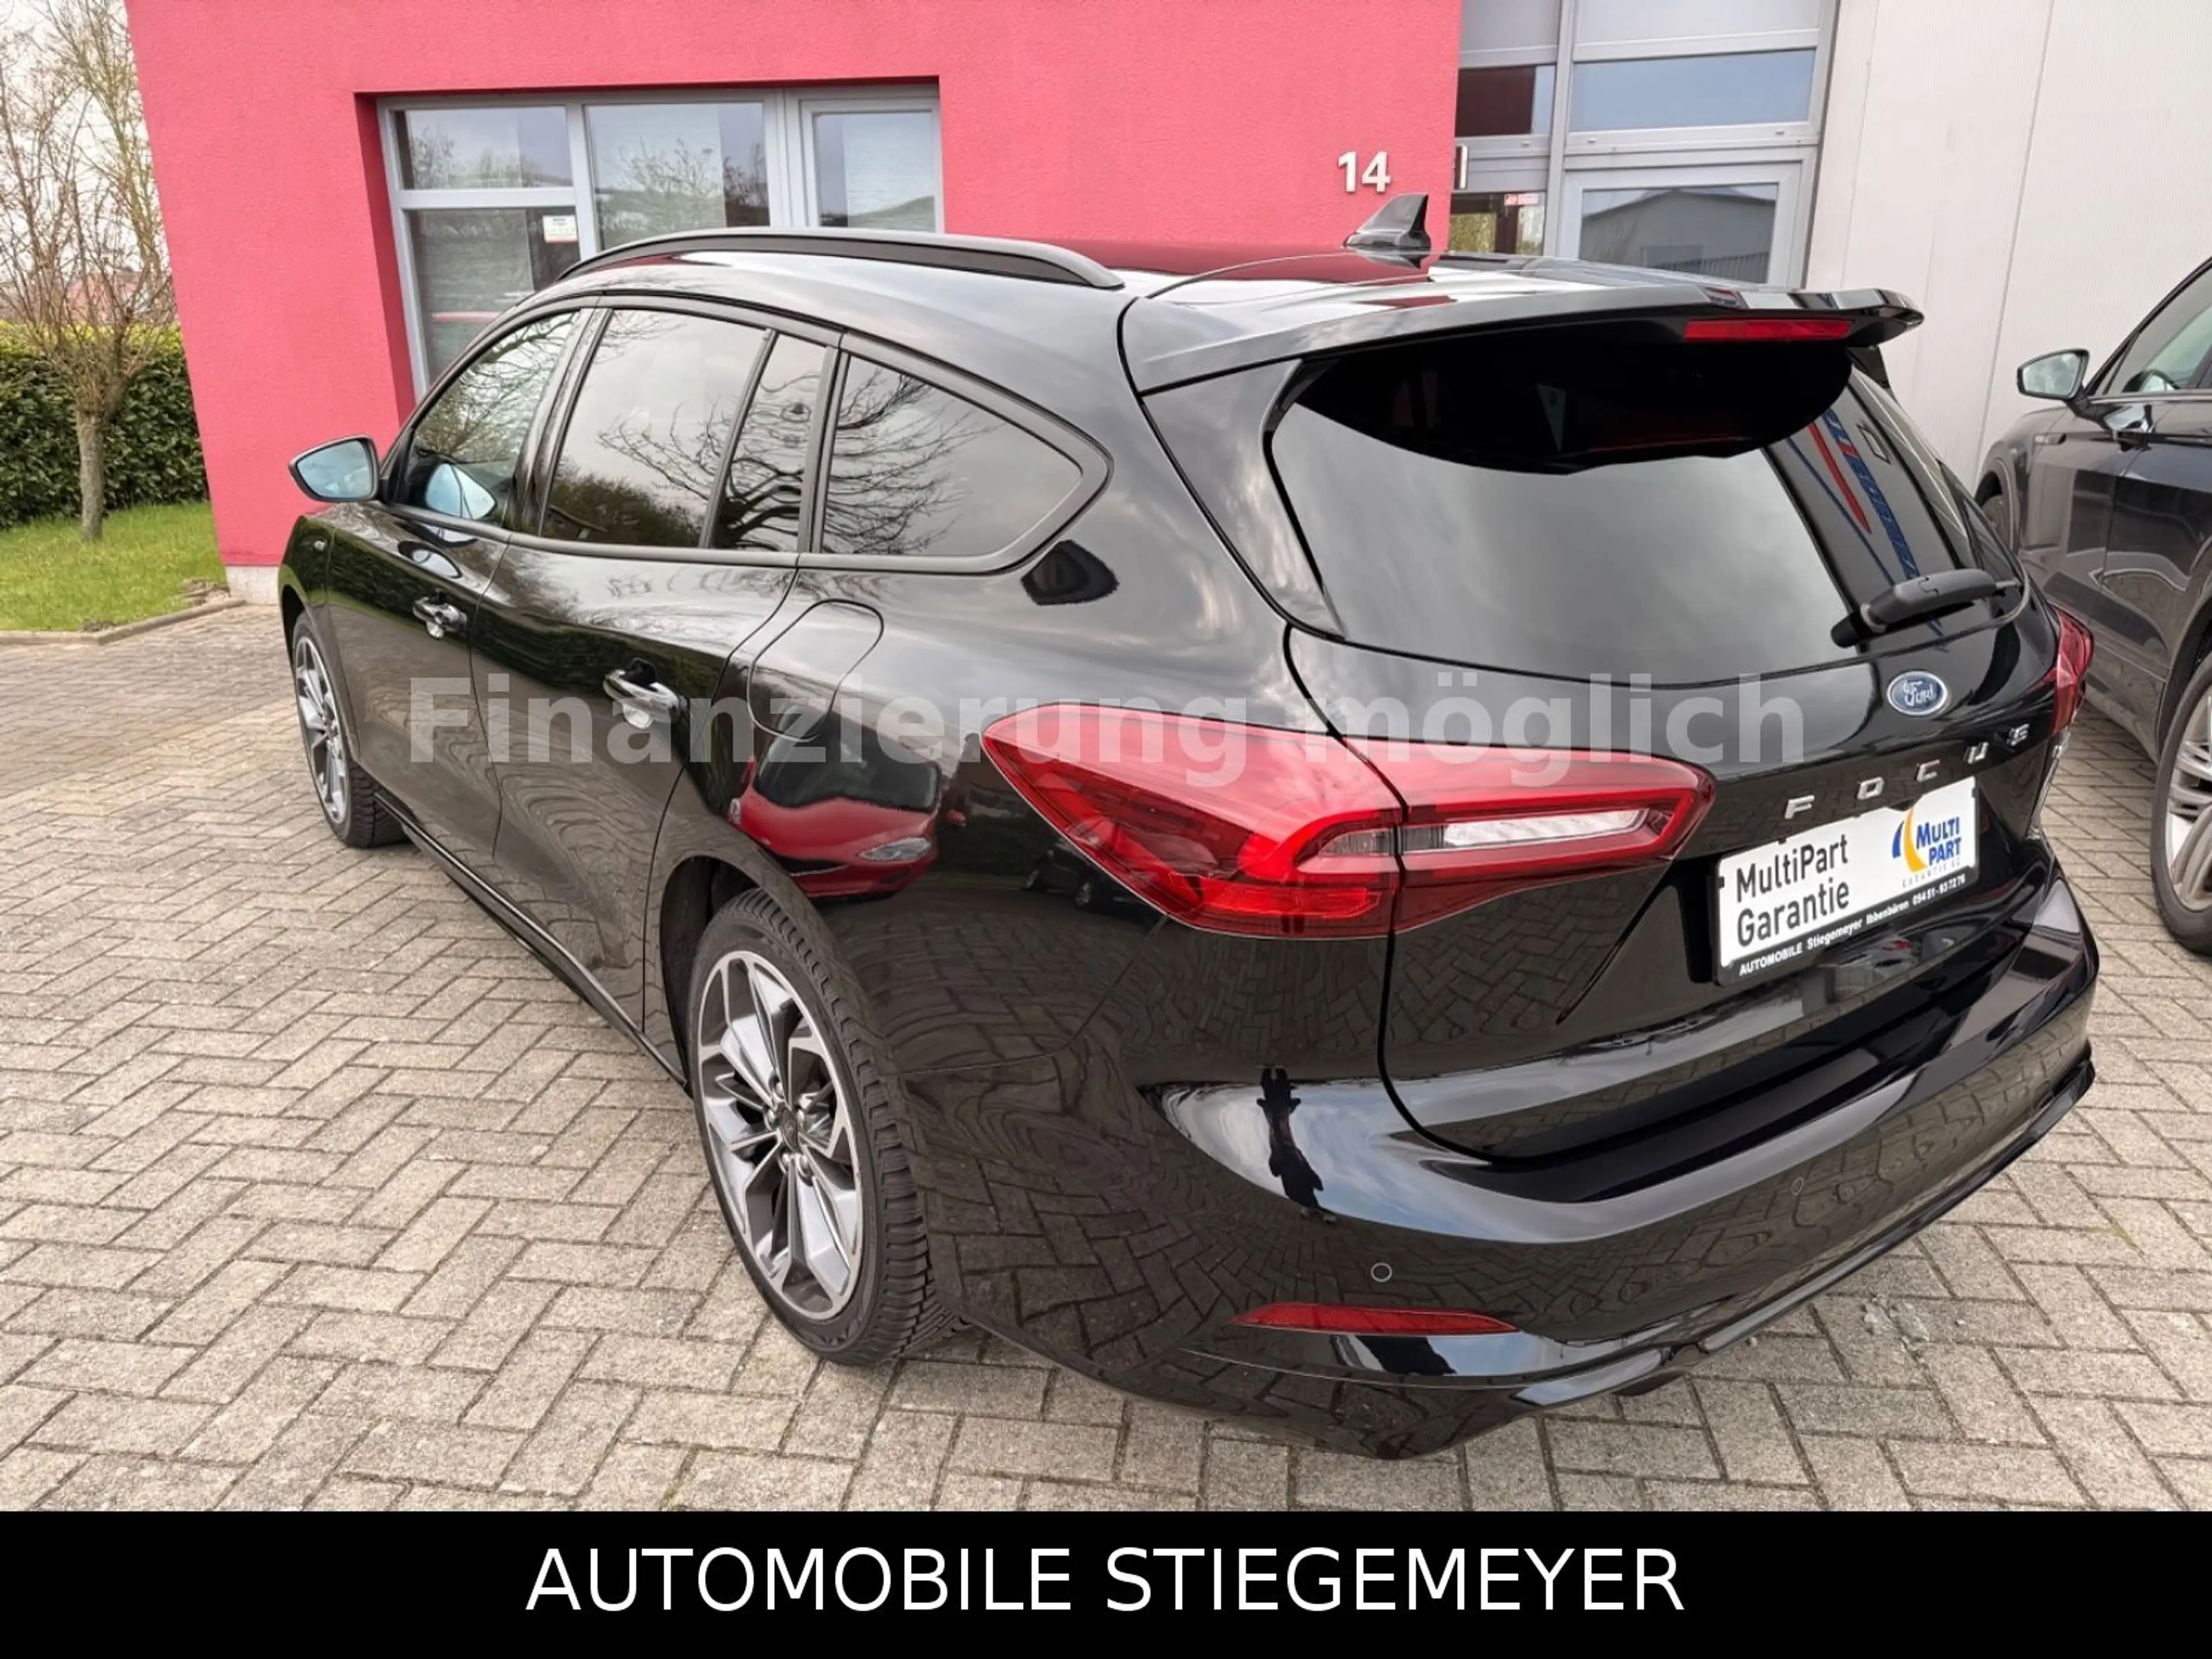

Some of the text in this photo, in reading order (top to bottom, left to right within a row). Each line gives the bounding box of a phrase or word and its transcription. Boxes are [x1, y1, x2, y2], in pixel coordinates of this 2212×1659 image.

[1337, 150, 1391, 193] 14
[1903, 679, 1936, 707] Ford
[1785, 724, 2030, 820] FOCUS
[1916, 816, 1960, 850] MULTI
[1929, 837, 1962, 866] PART
[1736, 834, 1849, 903] MultiPart
[1737, 876, 1850, 948] Garantie
[1739, 942, 1803, 976] AUTOMOBILE
[1806, 918, 1863, 951] Stiegemeyer
